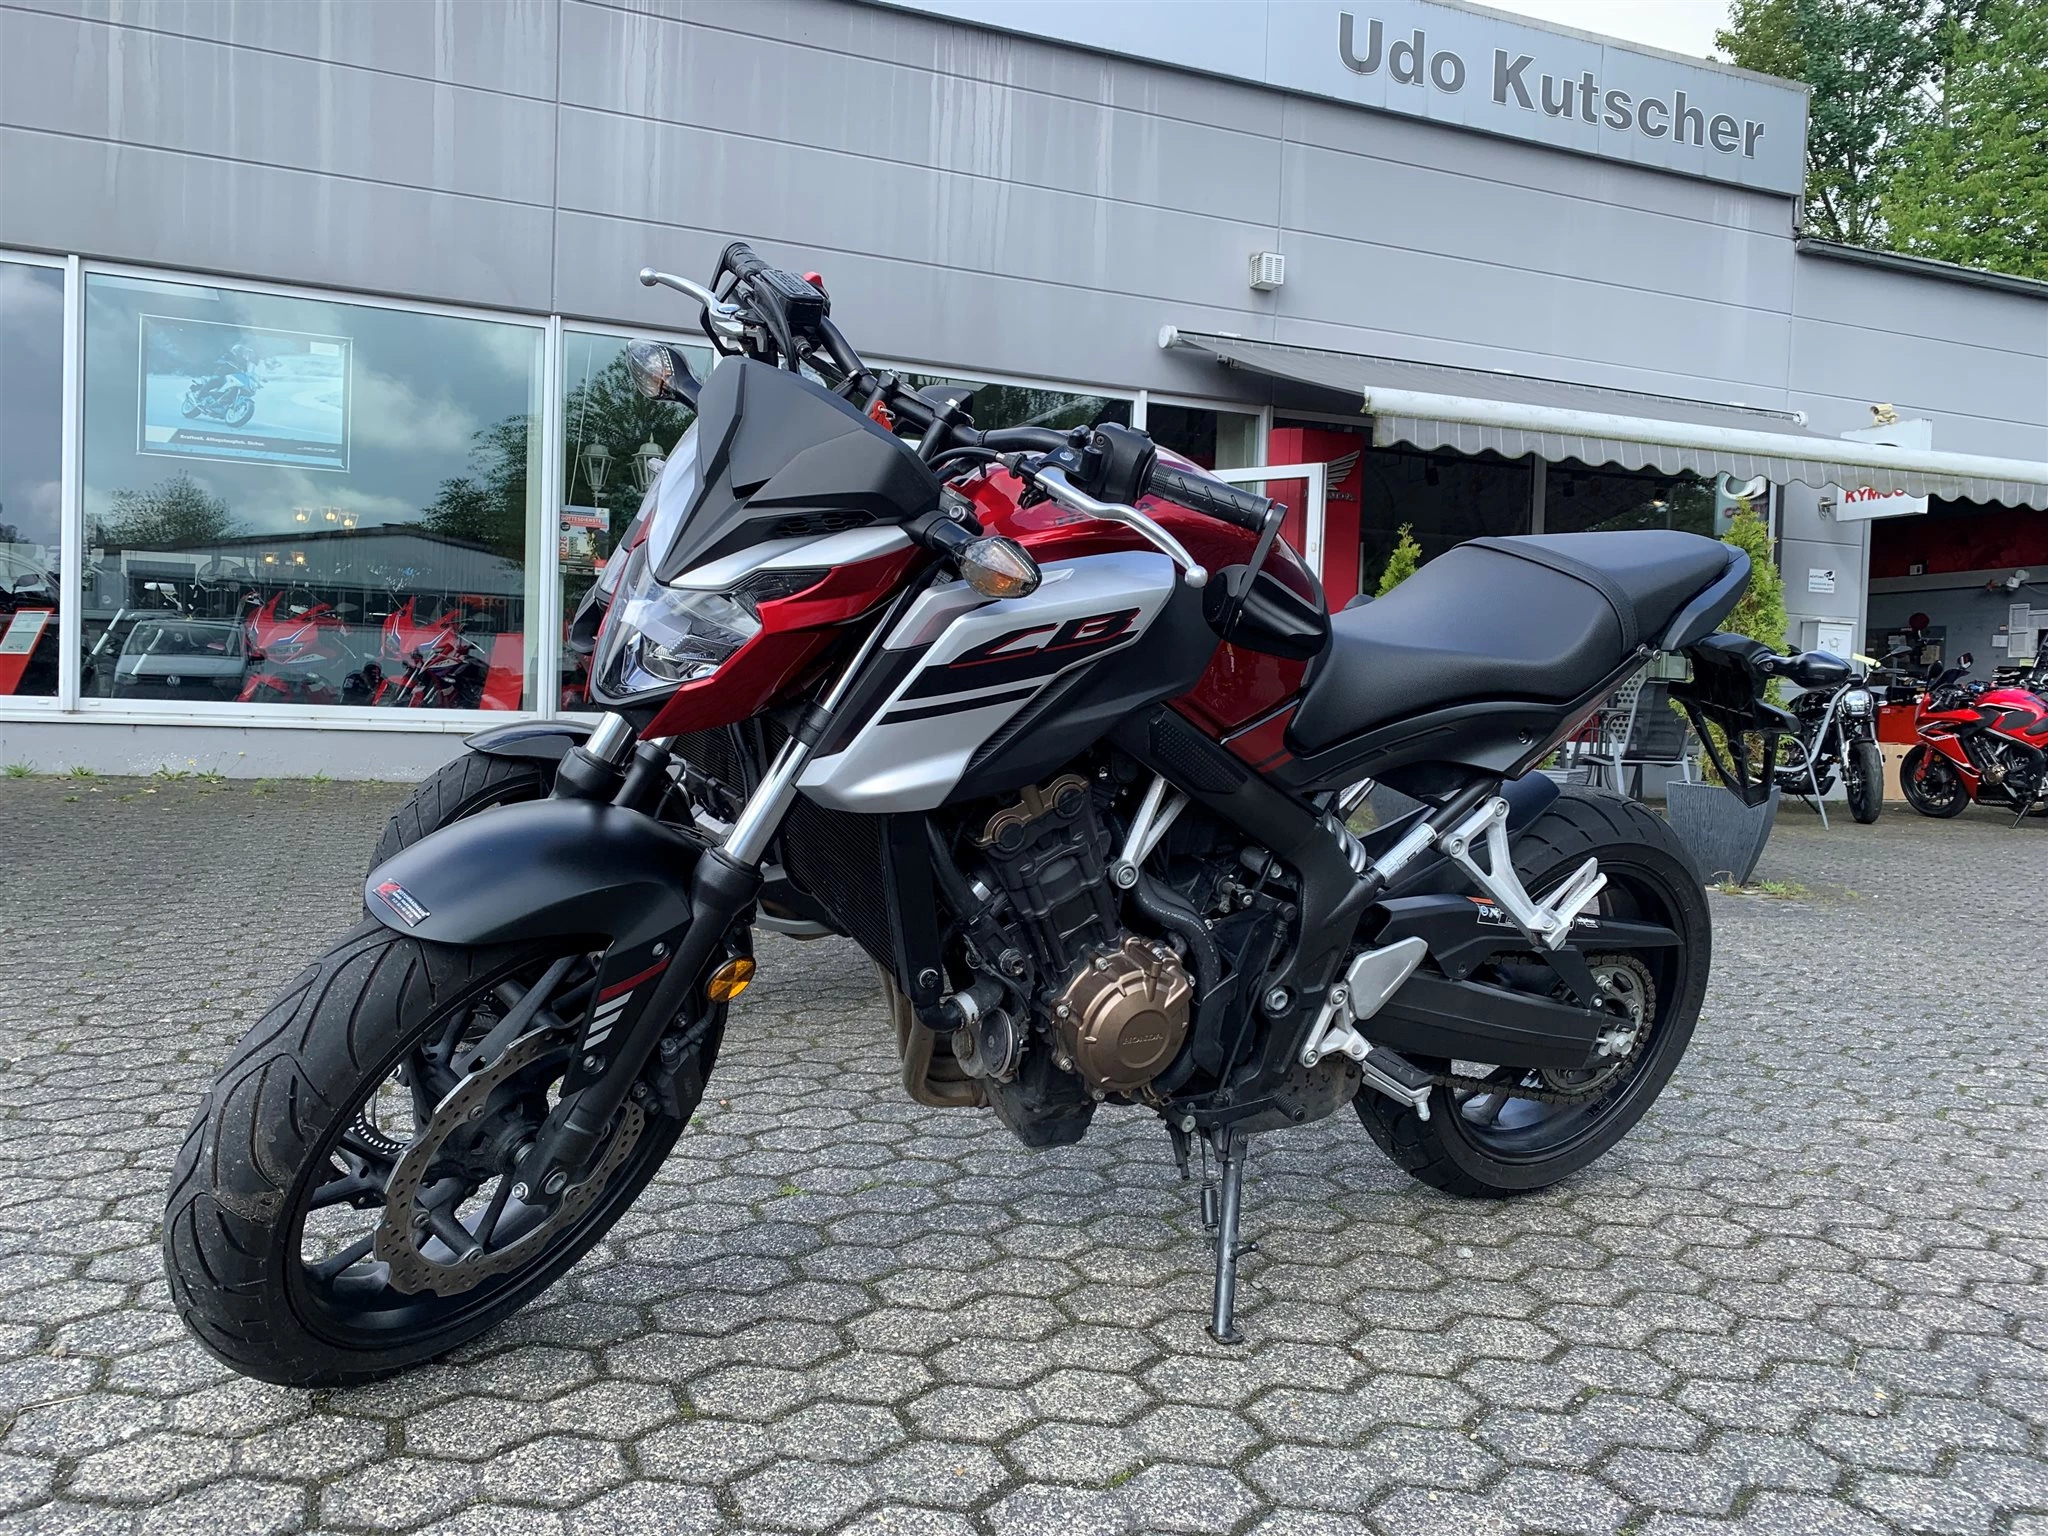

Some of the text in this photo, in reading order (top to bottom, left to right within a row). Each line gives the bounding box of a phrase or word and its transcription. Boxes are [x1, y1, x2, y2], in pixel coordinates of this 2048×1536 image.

[1337, 10, 1766, 159] Udo Kutscher
[560, 536, 568, 560] 2026
[949, 606, 1143, 670] CB
[1122, 1033, 1164, 1045] HONDA
